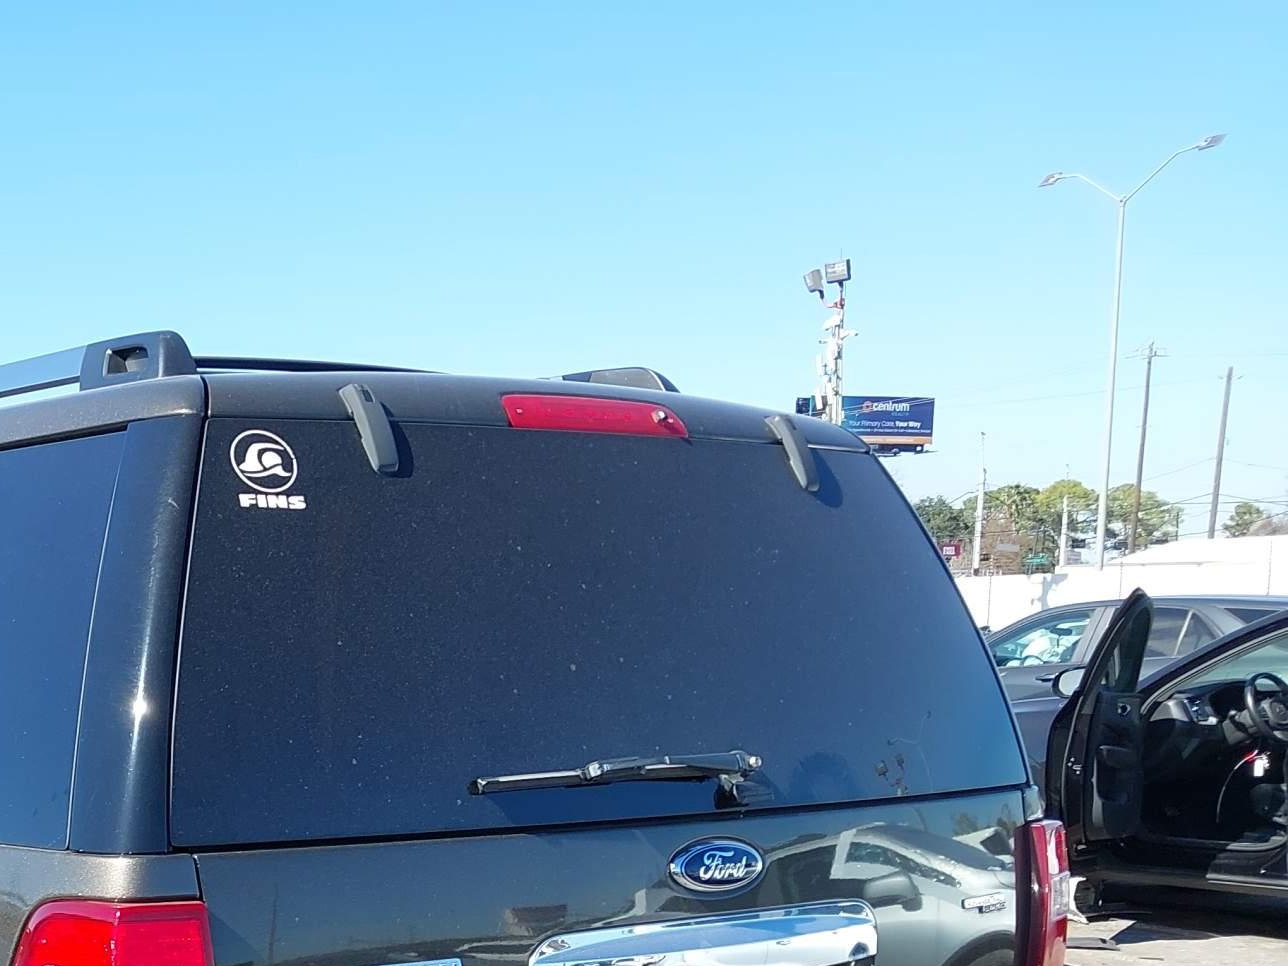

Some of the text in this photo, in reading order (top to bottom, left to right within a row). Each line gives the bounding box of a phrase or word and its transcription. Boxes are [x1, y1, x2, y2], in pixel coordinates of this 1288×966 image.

[872, 401, 910, 412] centrum
[238, 493, 306, 509] FINS
[699, 850, 747, 881] Ford
